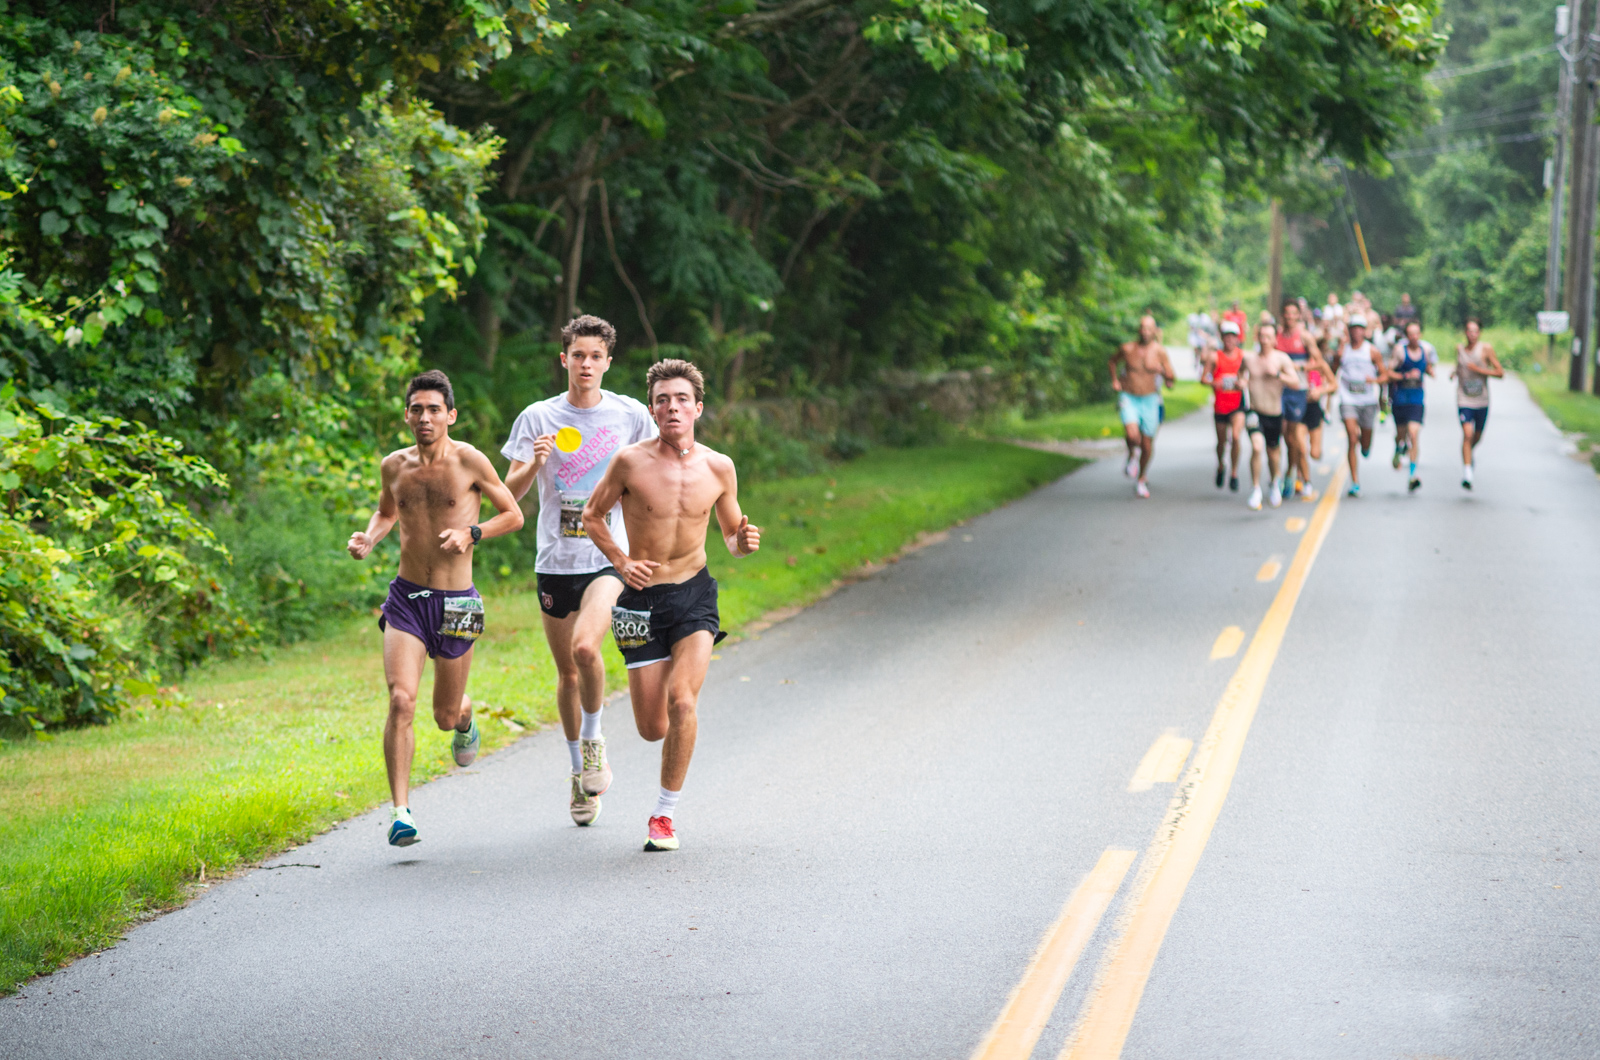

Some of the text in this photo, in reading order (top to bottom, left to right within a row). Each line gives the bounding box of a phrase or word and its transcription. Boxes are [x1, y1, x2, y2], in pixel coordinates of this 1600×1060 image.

[557, 425, 612, 479] chilmark
[565, 434, 620, 488] road race
[461, 611, 472, 628] 4
[612, 620, 649, 638] 1800
